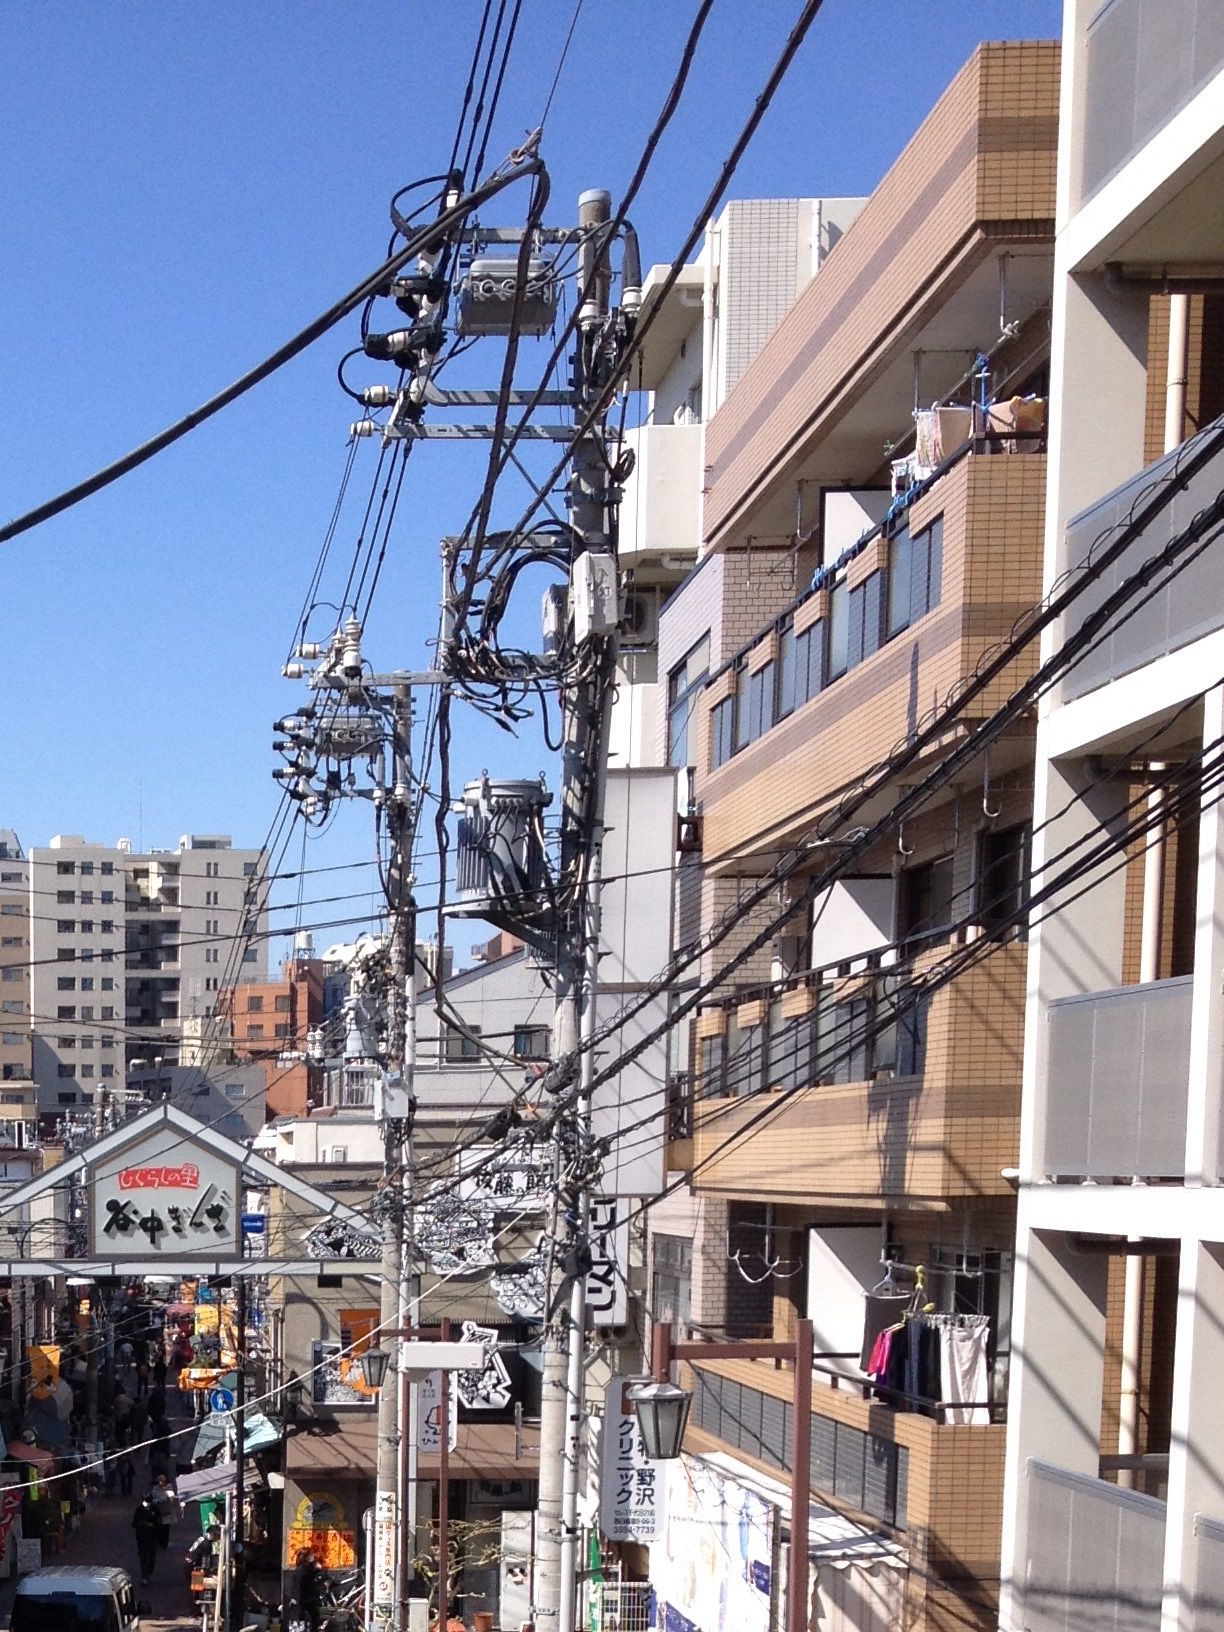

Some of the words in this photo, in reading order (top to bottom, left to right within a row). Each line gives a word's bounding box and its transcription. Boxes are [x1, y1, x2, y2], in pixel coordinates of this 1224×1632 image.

[103, 1183, 232, 1244] 谷中ぎんざ
[588, 1199, 617, 1311] リーマン
[616, 1419, 635, 1505] クリニック
